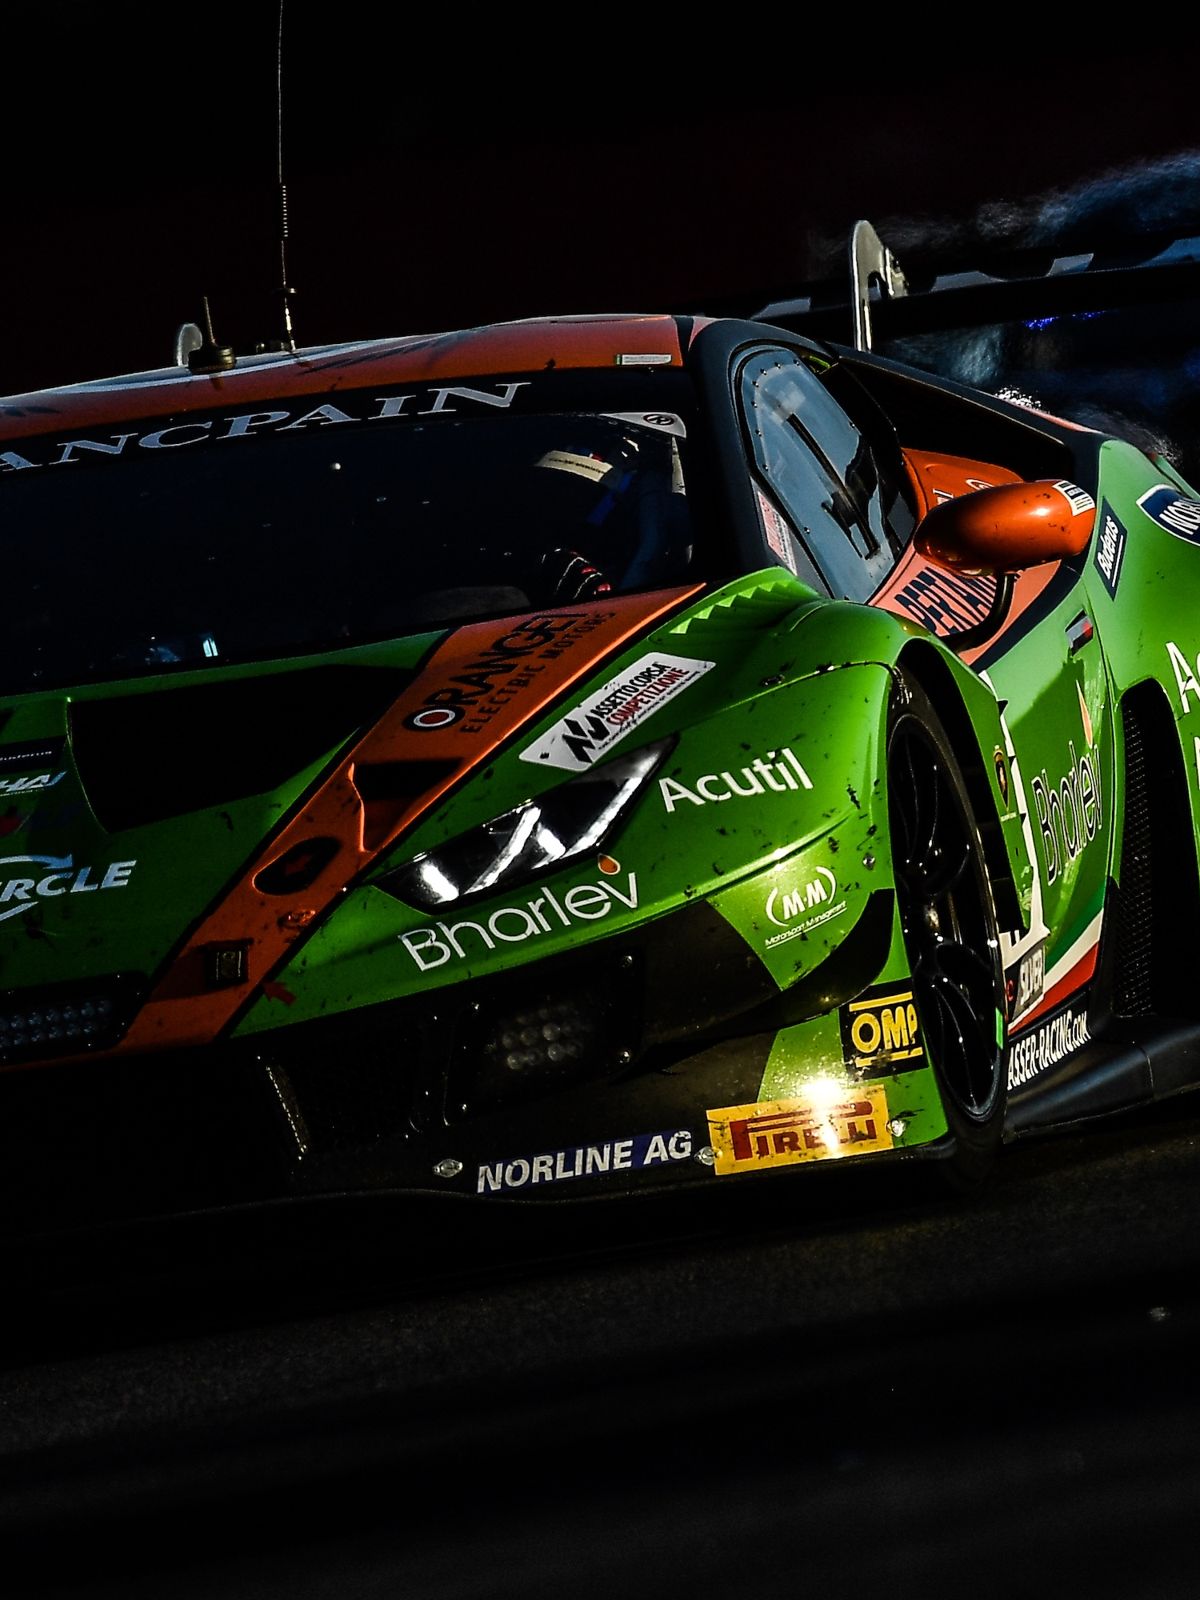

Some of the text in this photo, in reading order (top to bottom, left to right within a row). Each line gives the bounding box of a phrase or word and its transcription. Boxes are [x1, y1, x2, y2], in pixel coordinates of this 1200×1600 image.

[590, 661, 672, 721] ASSETTO CORSA
[605, 667, 691, 727] COMPETIZIONE
[658, 747, 814, 813] Acutil
[0, 860, 138, 902] RCLE
[398, 872, 639, 971] Bharlev
[1020, 949, 1043, 1006] SILVER
[851, 1003, 918, 1054] OMP
[477, 1130, 693, 1194] NORLINE AG
